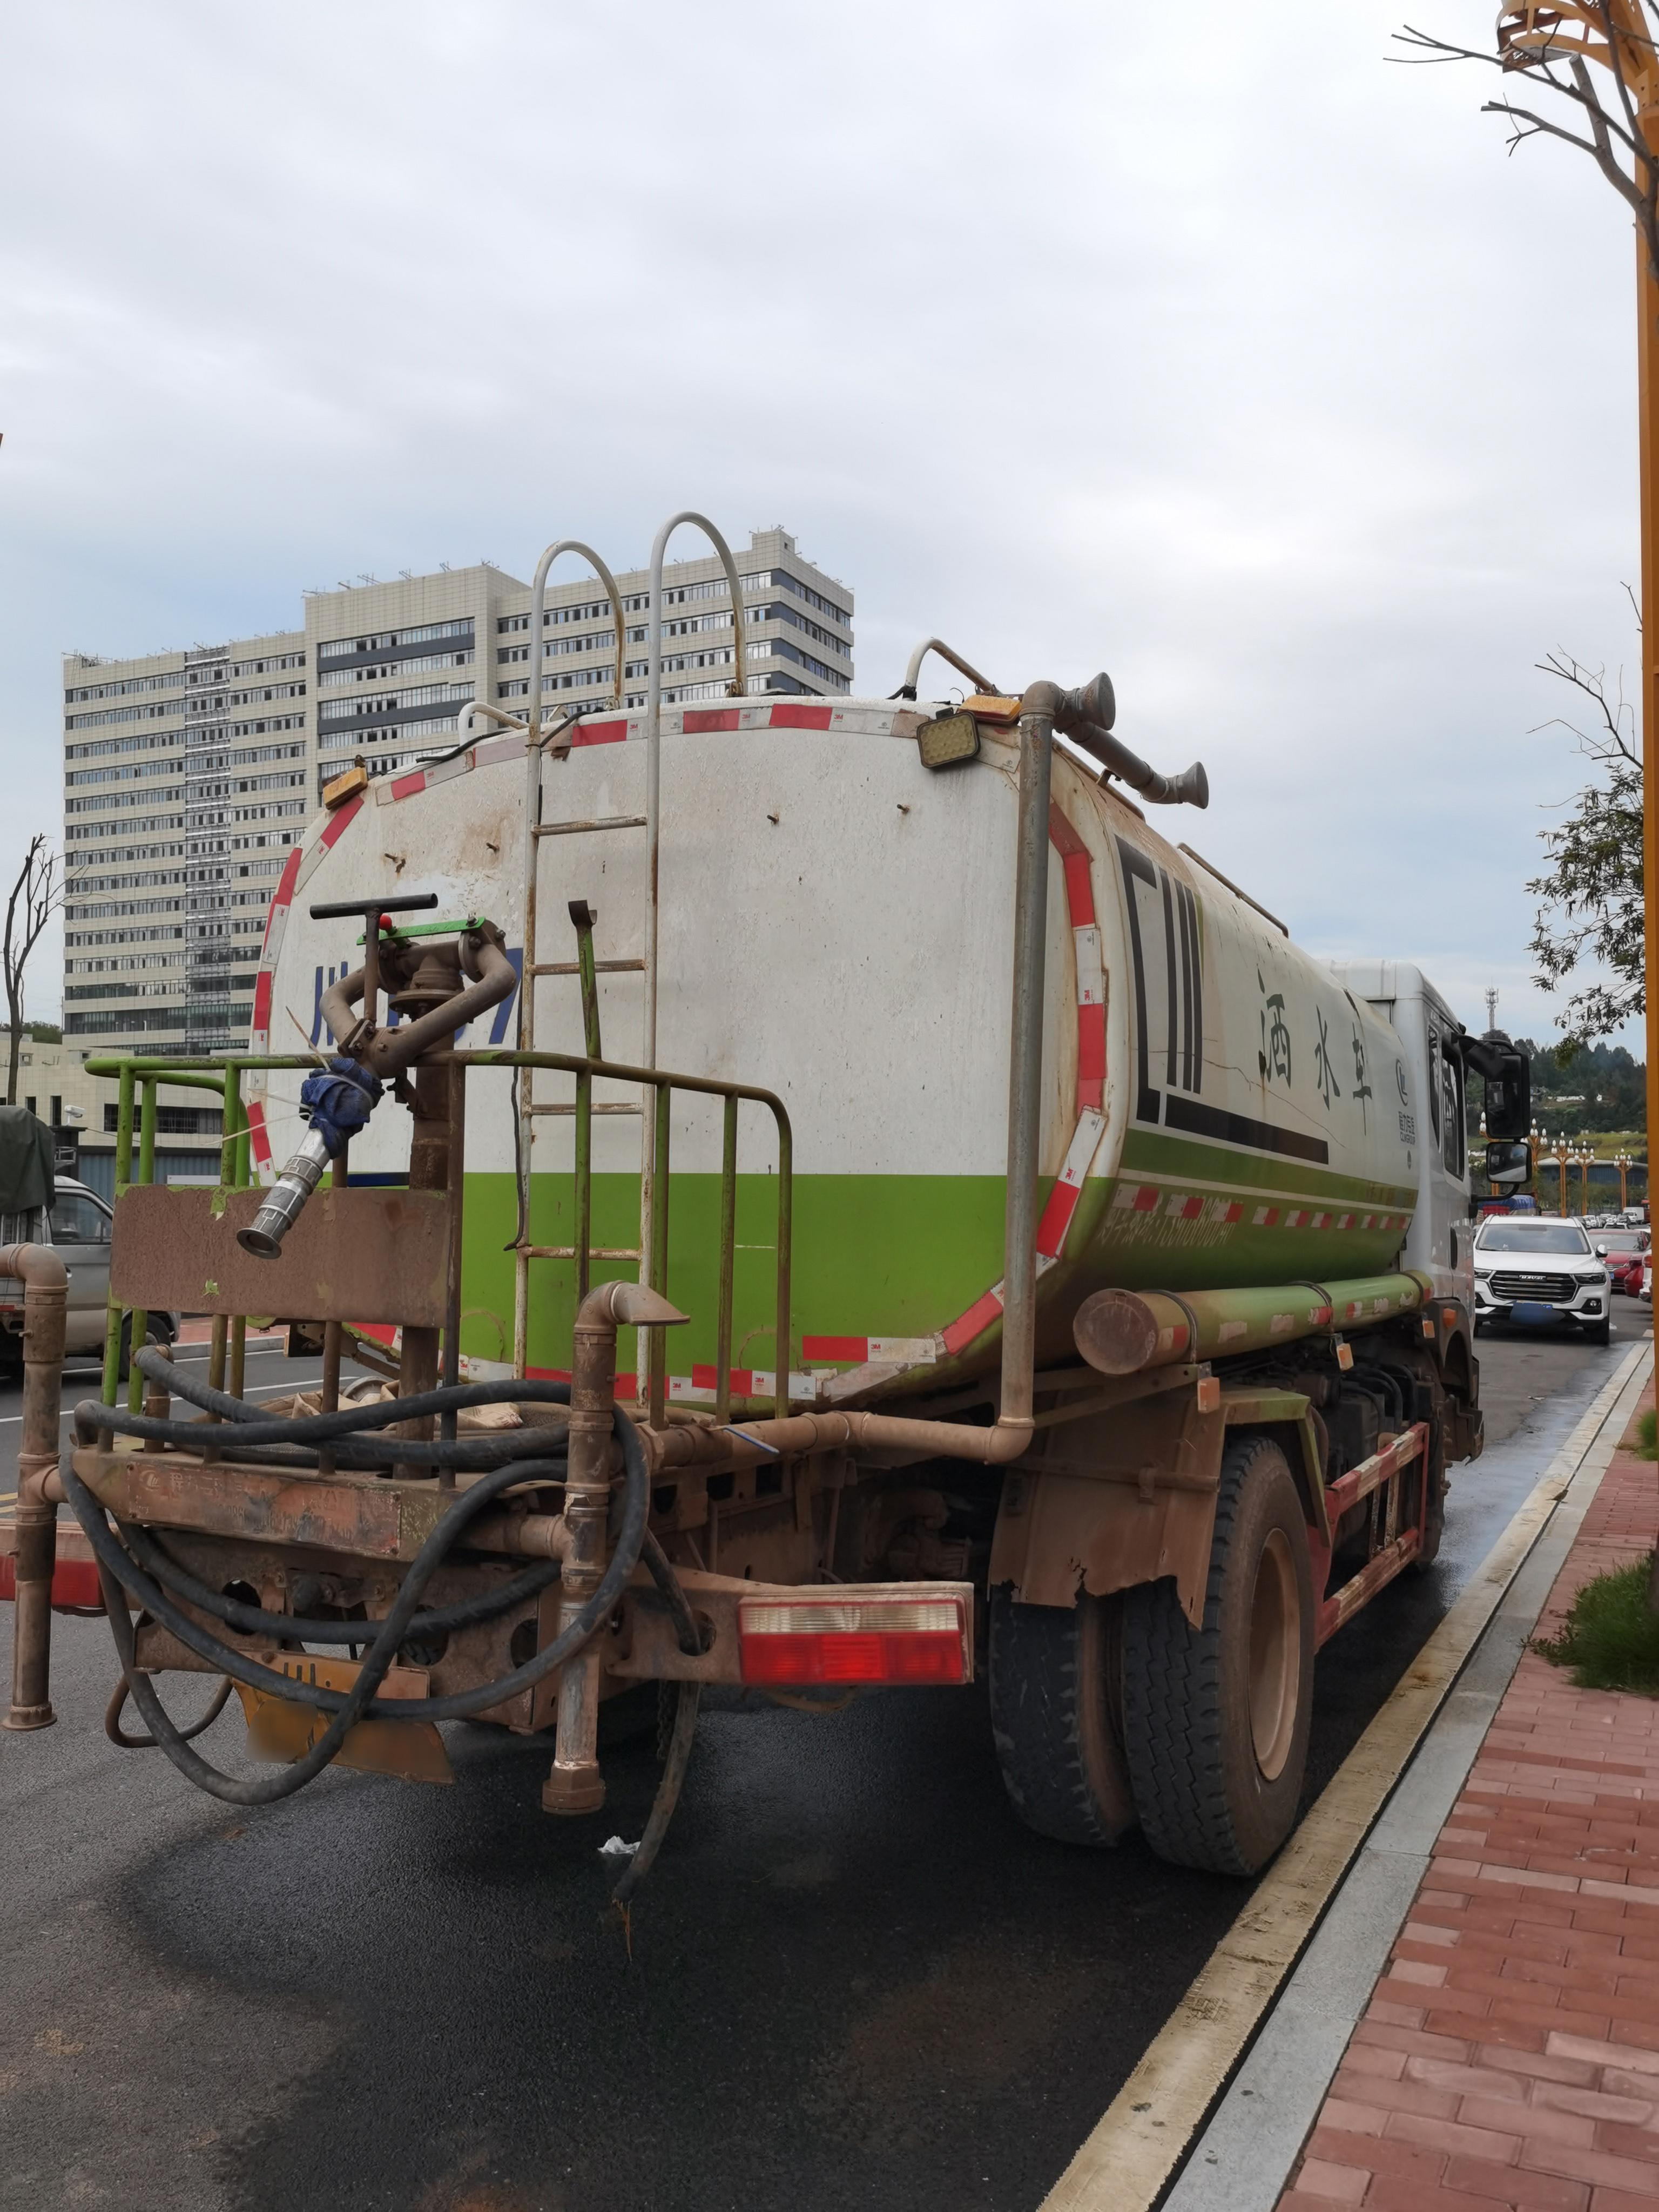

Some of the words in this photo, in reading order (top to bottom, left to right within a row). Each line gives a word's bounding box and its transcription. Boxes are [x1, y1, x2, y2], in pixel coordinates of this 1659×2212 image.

[318, 846, 325, 854] 3M
[280, 907, 285, 916] 3M
[1084, 990, 1090, 1001] 3M
[260, 1033, 264, 1042] 3M
[1256, 963, 1372, 1136] 洒水车
[266, 1162, 270, 1171] 3M
[1065, 1168, 1073, 1180] 3M
